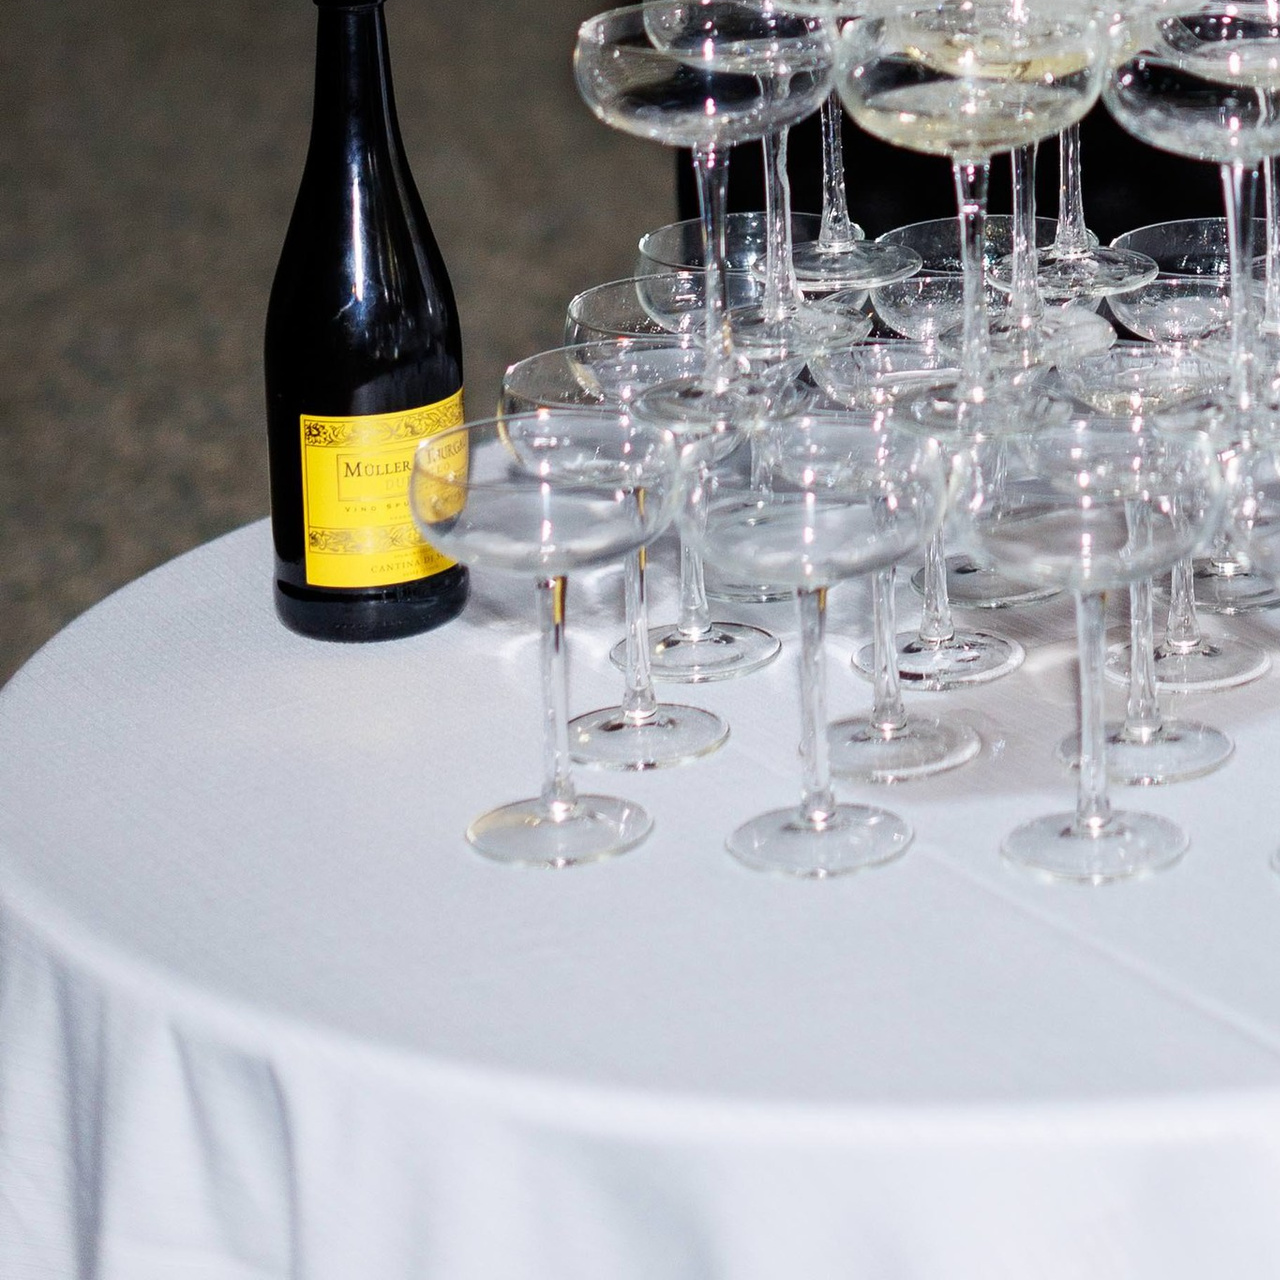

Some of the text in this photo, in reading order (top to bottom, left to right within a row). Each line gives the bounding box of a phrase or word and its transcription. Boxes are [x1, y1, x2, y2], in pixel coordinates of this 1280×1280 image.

[344, 460, 412, 478] MÜLLER
[344, 505, 377, 513] VINO
[371, 559, 421, 574] CANTINA
